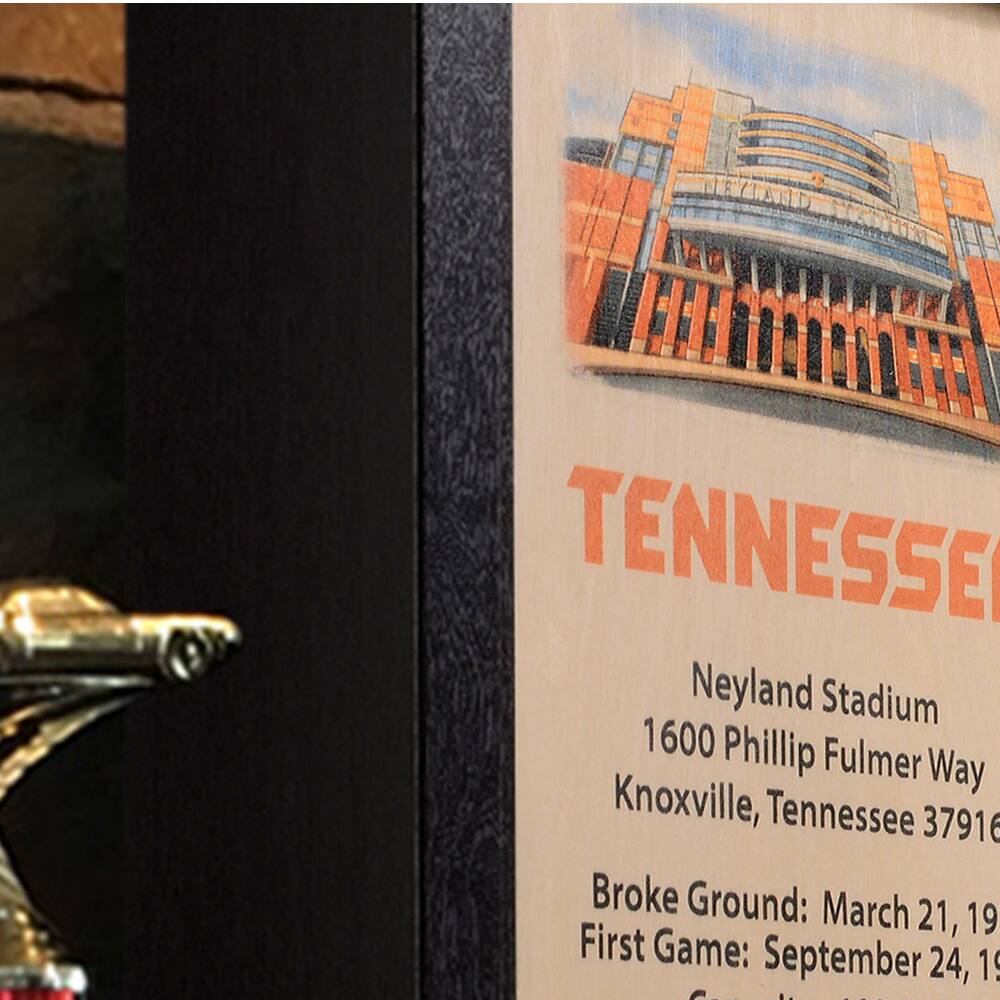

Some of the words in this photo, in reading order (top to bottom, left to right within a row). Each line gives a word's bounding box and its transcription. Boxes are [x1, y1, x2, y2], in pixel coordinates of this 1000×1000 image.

[692, 661, 813, 712] Neyland
[822, 678, 938, 725] Stadium
[644, 716, 716, 759] 1600
[724, 724, 816, 778] Phillip
[824, 736, 922, 780] Fulmer
[928, 747, 986, 795] Way
[615, 772, 760, 829] Knoxville,
[766, 788, 915, 836] Tennessee
[592, 871, 679, 915] Broke
[687, 880, 808, 924] Ground:
[823, 890, 909, 930] March
[918, 898, 958, 938] 21,
[581, 921, 645, 963] First
[653, 927, 749, 969] Game:
[764, 933, 922, 981] September
[929, 945, 969, 985] 24,
